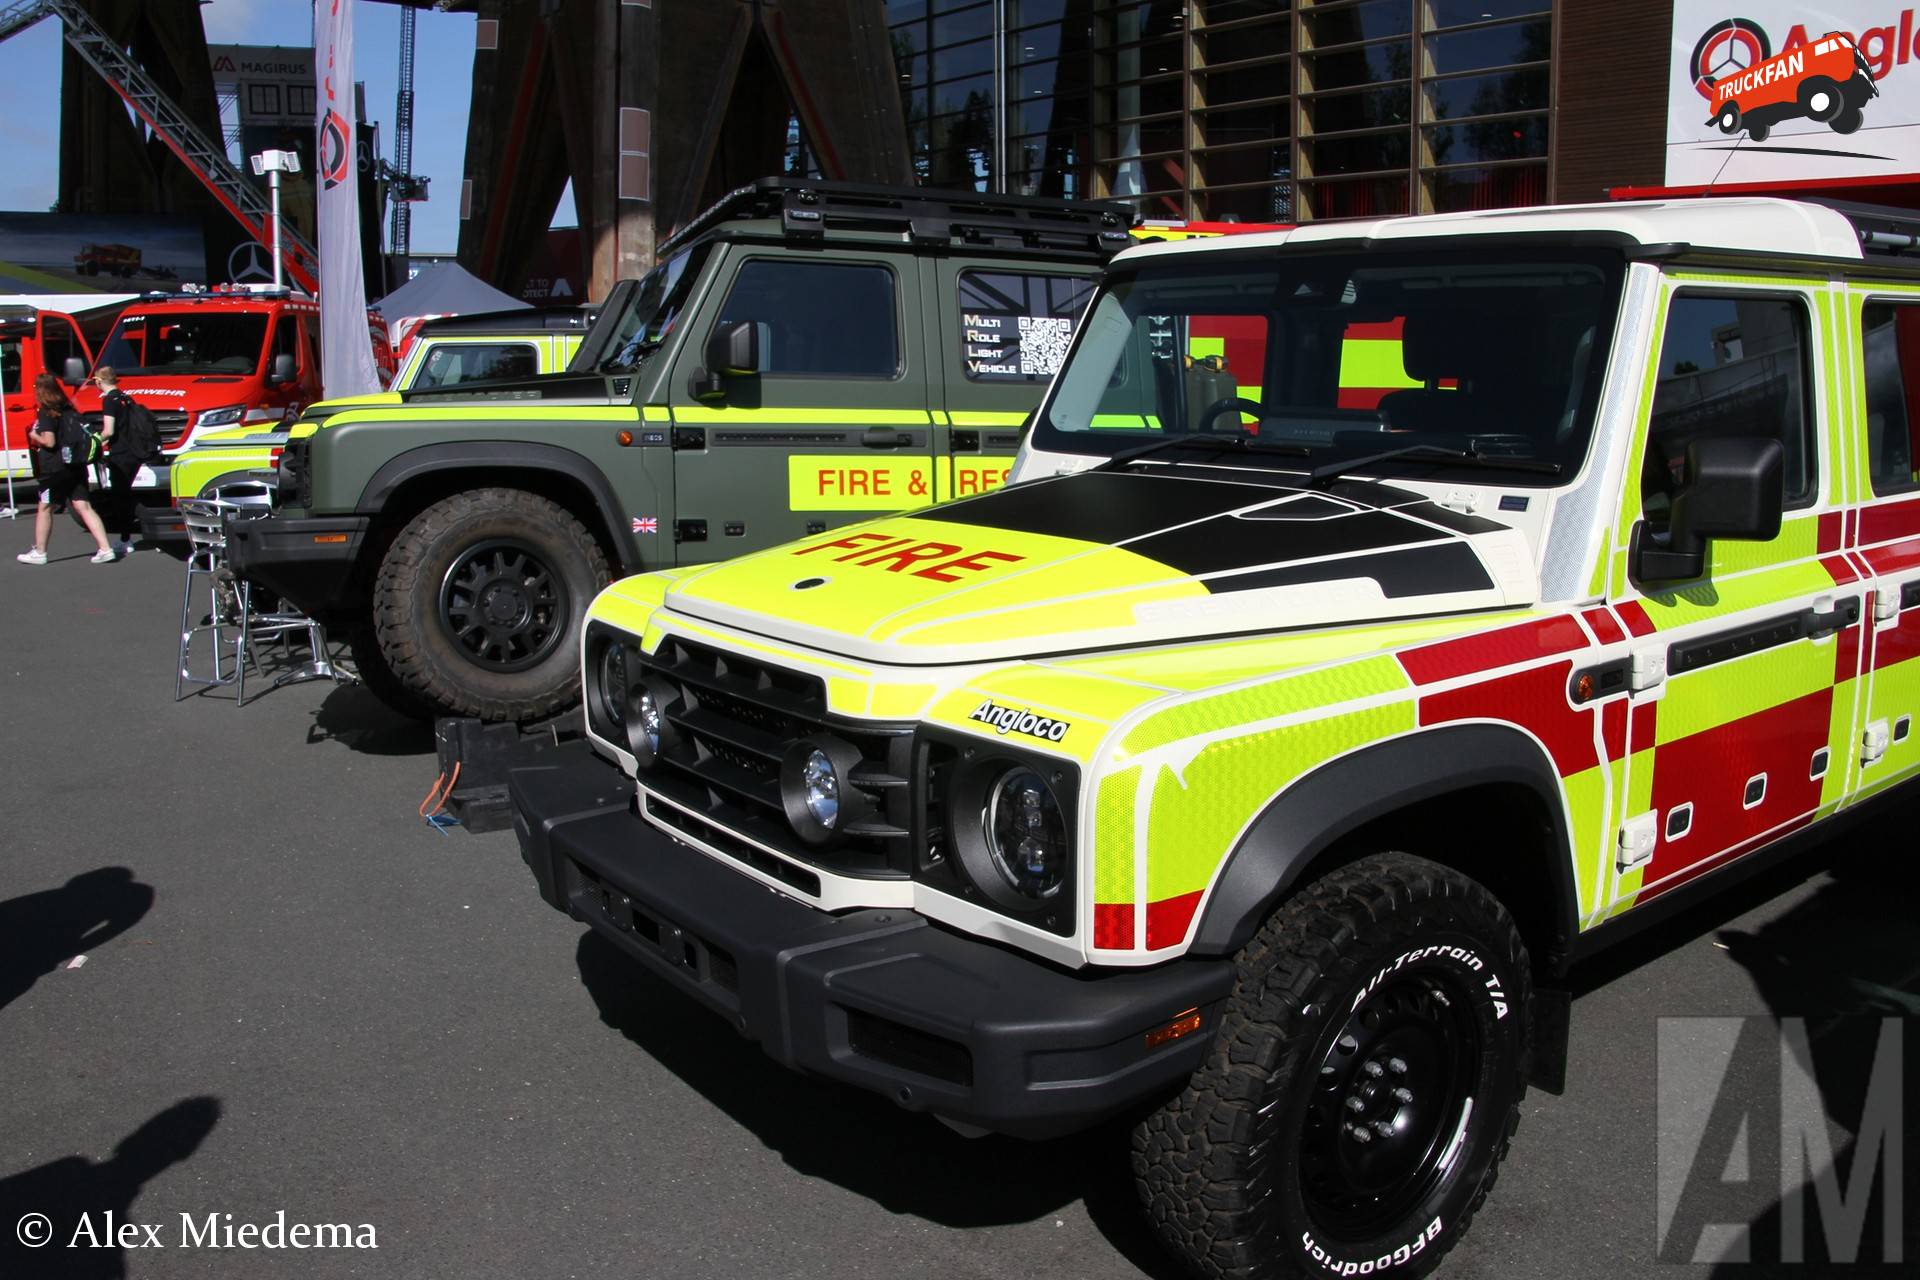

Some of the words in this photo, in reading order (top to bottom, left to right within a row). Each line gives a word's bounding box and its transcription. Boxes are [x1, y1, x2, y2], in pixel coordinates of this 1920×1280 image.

[241, 62, 306, 74] MAGIRUS
[818, 469, 891, 496] FIRE
[908, 469, 928, 496] &
[790, 532, 1027, 583] FIRE
[969, 698, 1068, 741] Angloco
[1350, 945, 1484, 1013] All-Terrain
[1485, 973, 1508, 1020] T/A
[1301, 1215, 1443, 1277] BFGoodrich
